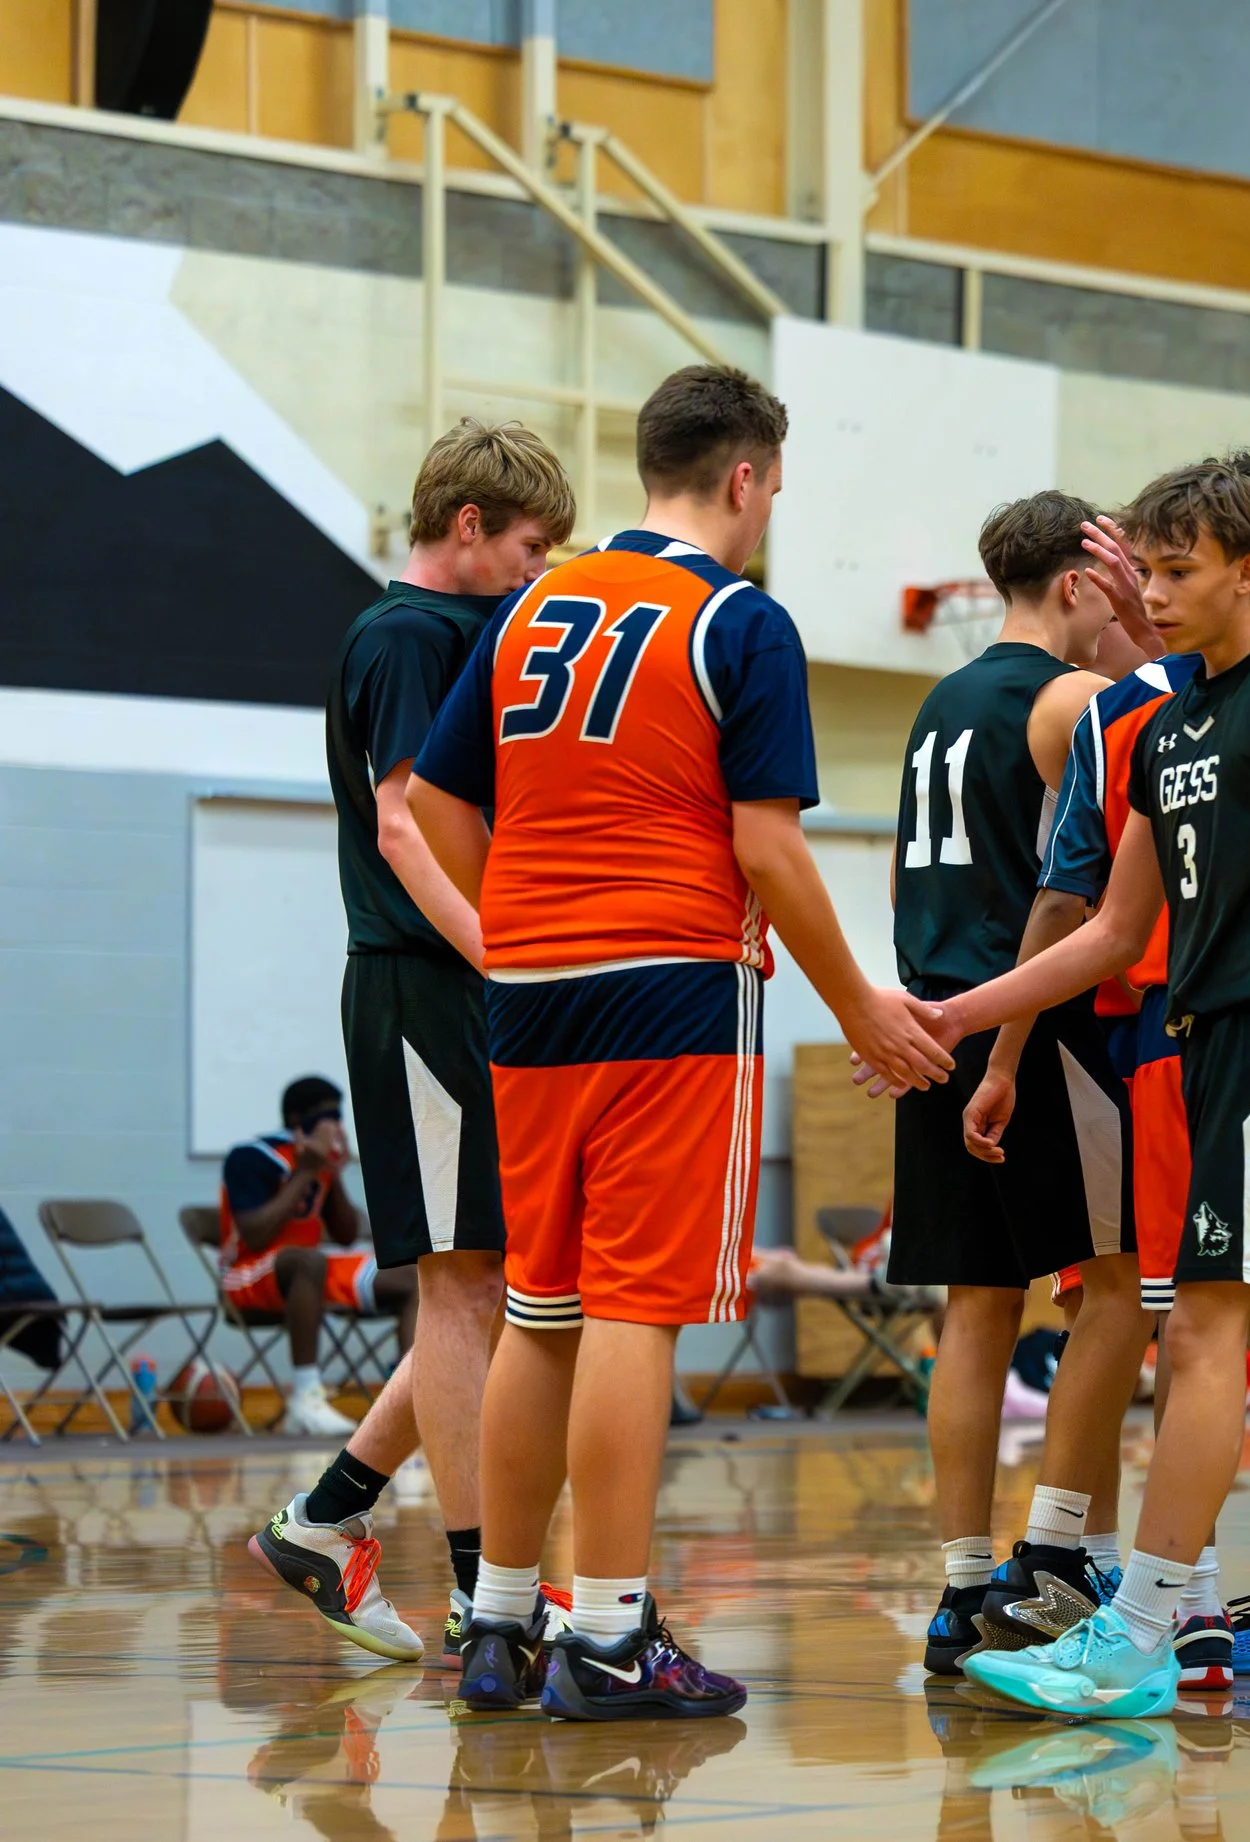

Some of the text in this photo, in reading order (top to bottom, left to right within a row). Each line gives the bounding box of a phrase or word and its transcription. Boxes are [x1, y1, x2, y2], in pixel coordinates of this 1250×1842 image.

[499, 594, 672, 745] 31
[905, 729, 974, 868] 11
[1159, 755, 1220, 814] GESS
[1177, 823, 1198, 900] 3
